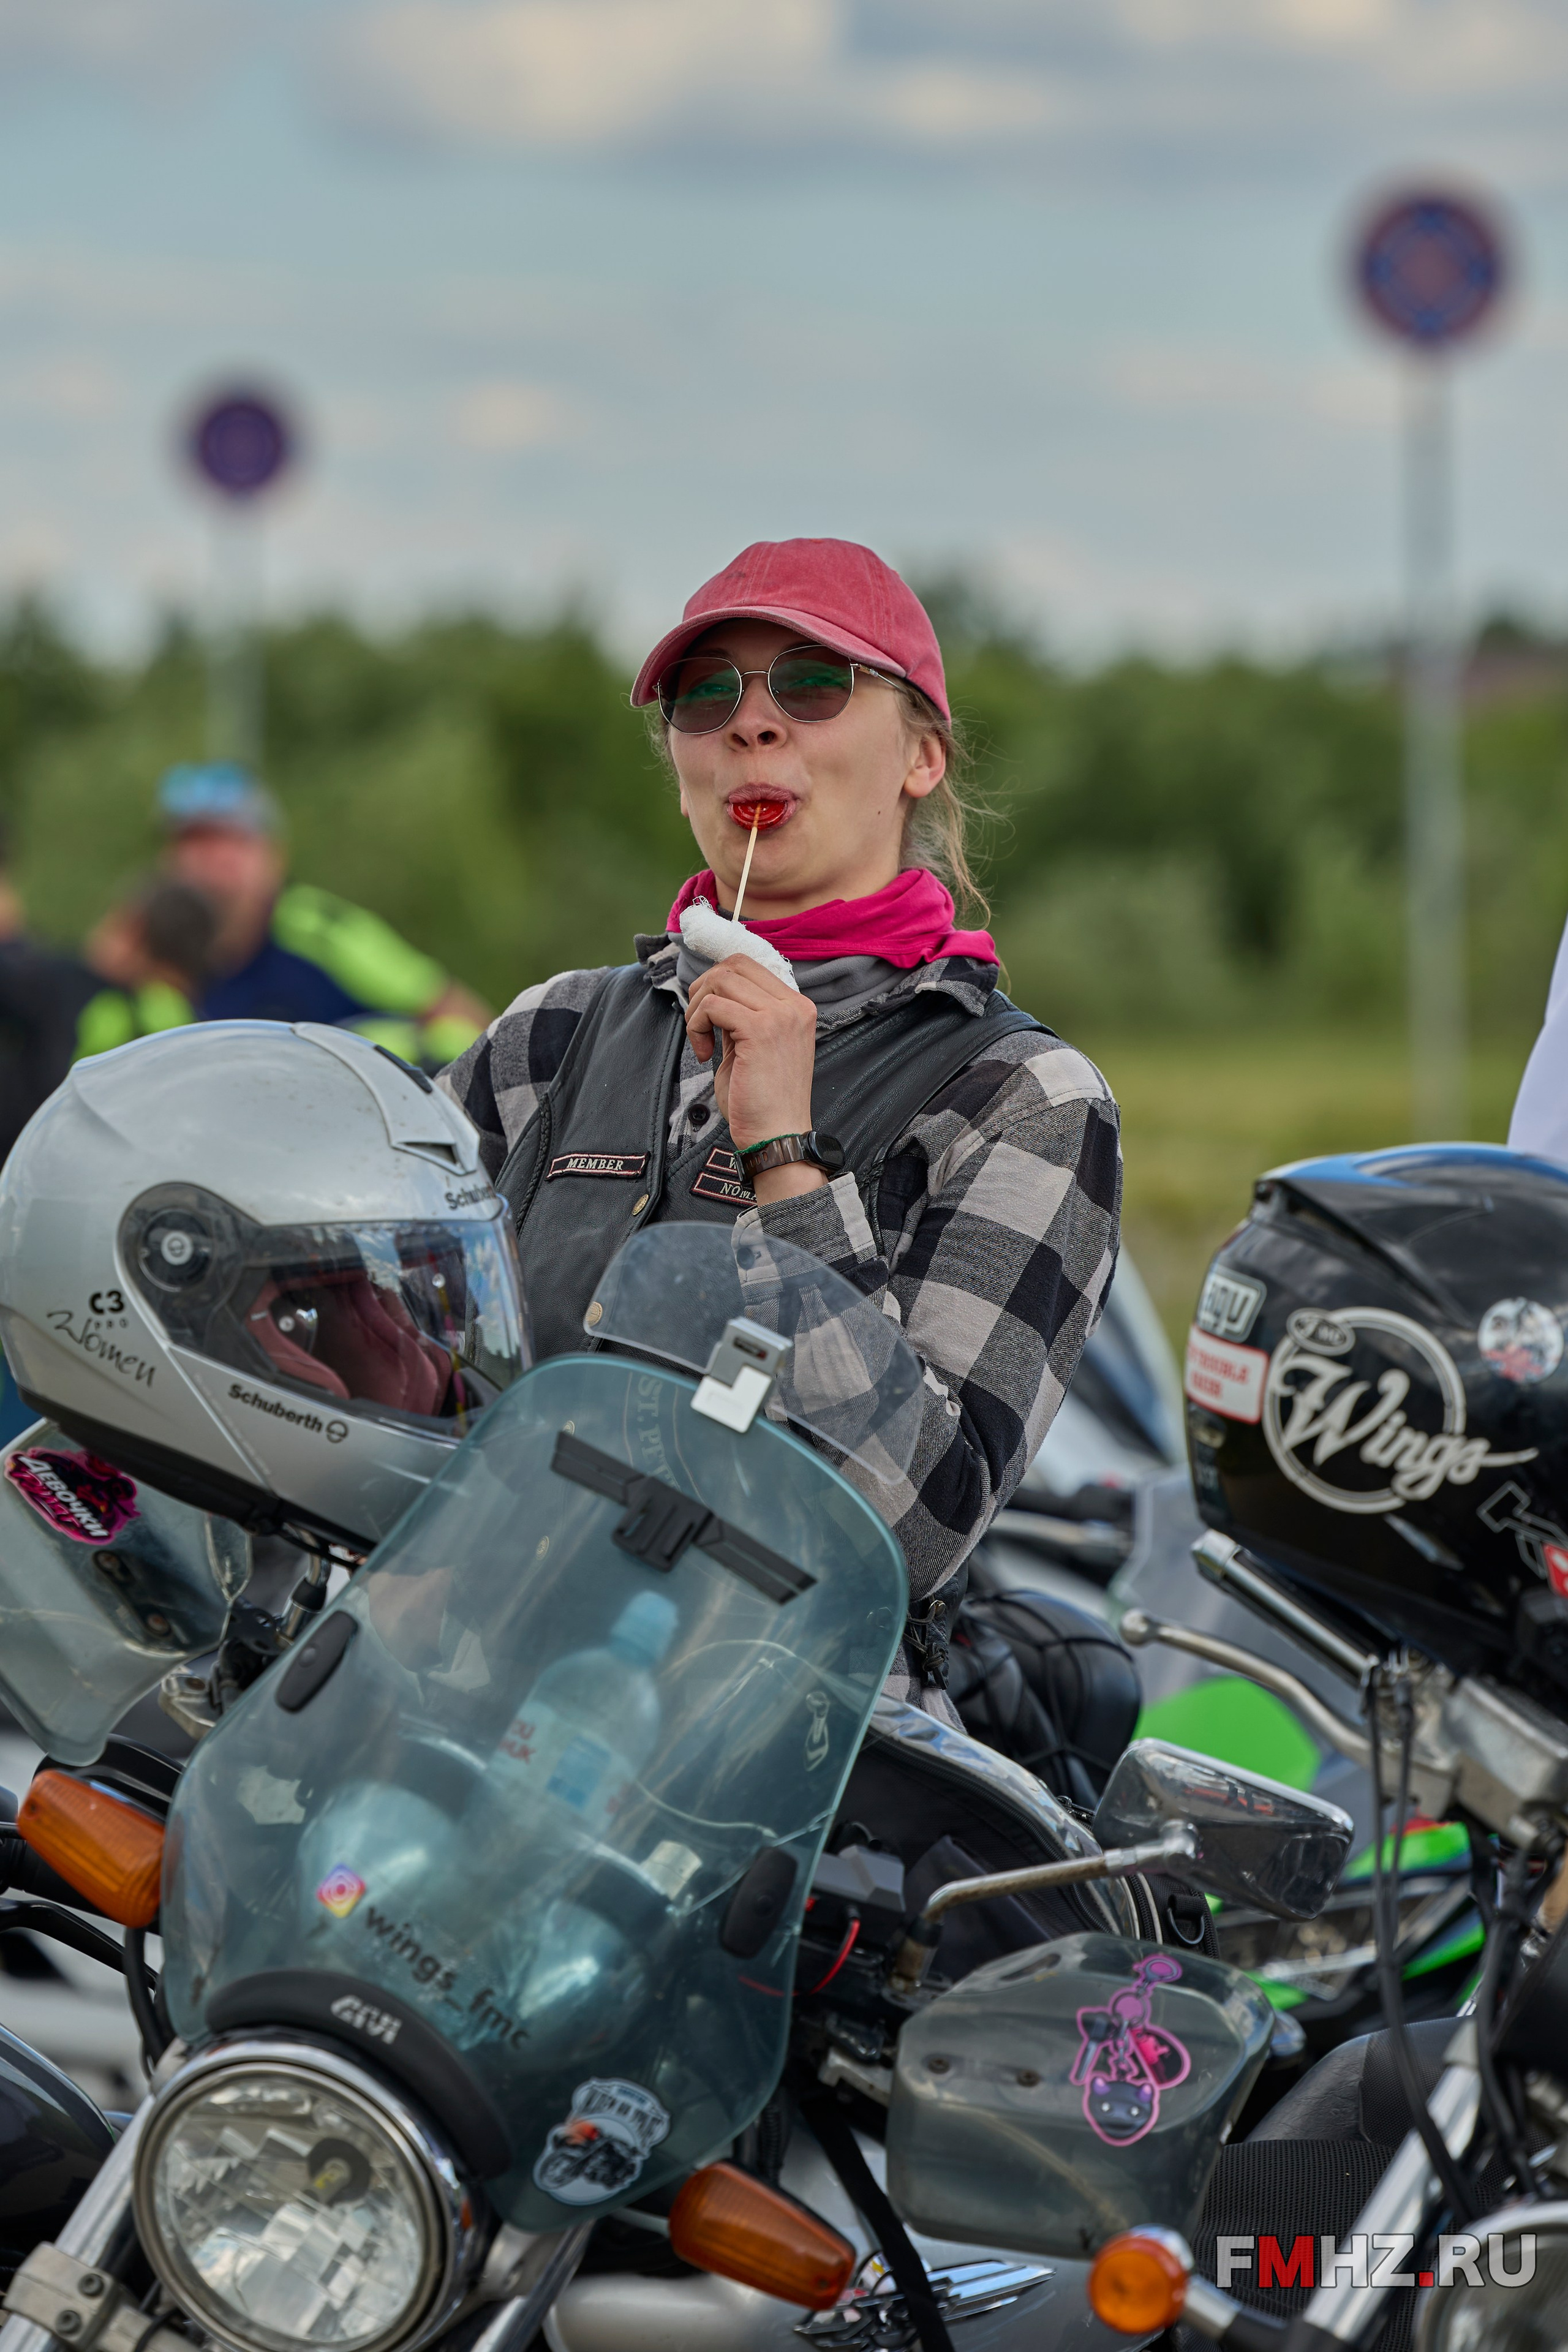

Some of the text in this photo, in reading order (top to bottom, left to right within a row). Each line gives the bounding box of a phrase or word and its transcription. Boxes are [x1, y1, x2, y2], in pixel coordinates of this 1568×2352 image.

[567, 1158, 624, 1170] MEMBER
[89, 1291, 125, 1315] C3
[228, 1384, 323, 1433] Schuberth
[1276, 1353, 1538, 1500] Wings
[366, 1906, 529, 2050] wings_fmc
